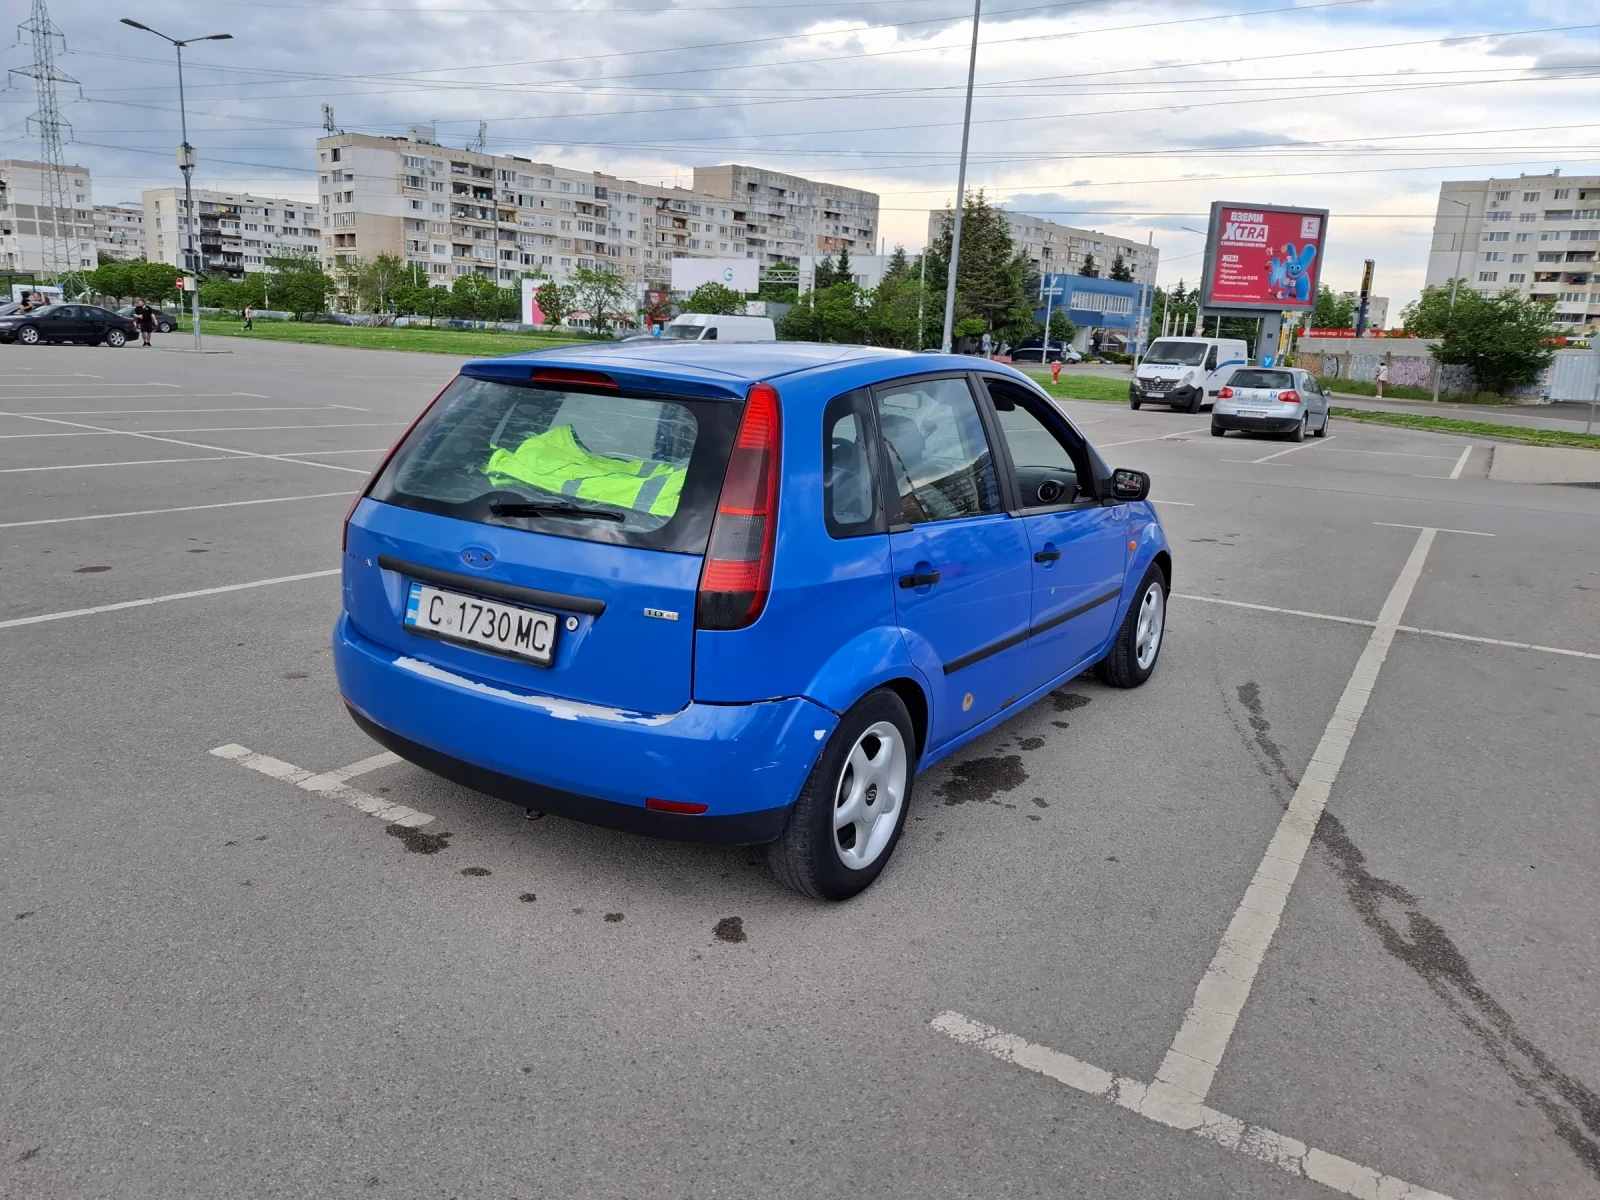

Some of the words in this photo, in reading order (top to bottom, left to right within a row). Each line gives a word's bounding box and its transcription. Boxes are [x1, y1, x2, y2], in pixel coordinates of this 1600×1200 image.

[1231, 212, 1263, 222] ВЗЕМИ
[1222, 222, 1268, 242] XTRA
[724, 268, 733, 281] G
[428, 595, 444, 626] C
[459, 602, 511, 642] 1730
[514, 615, 549, 652] MC
